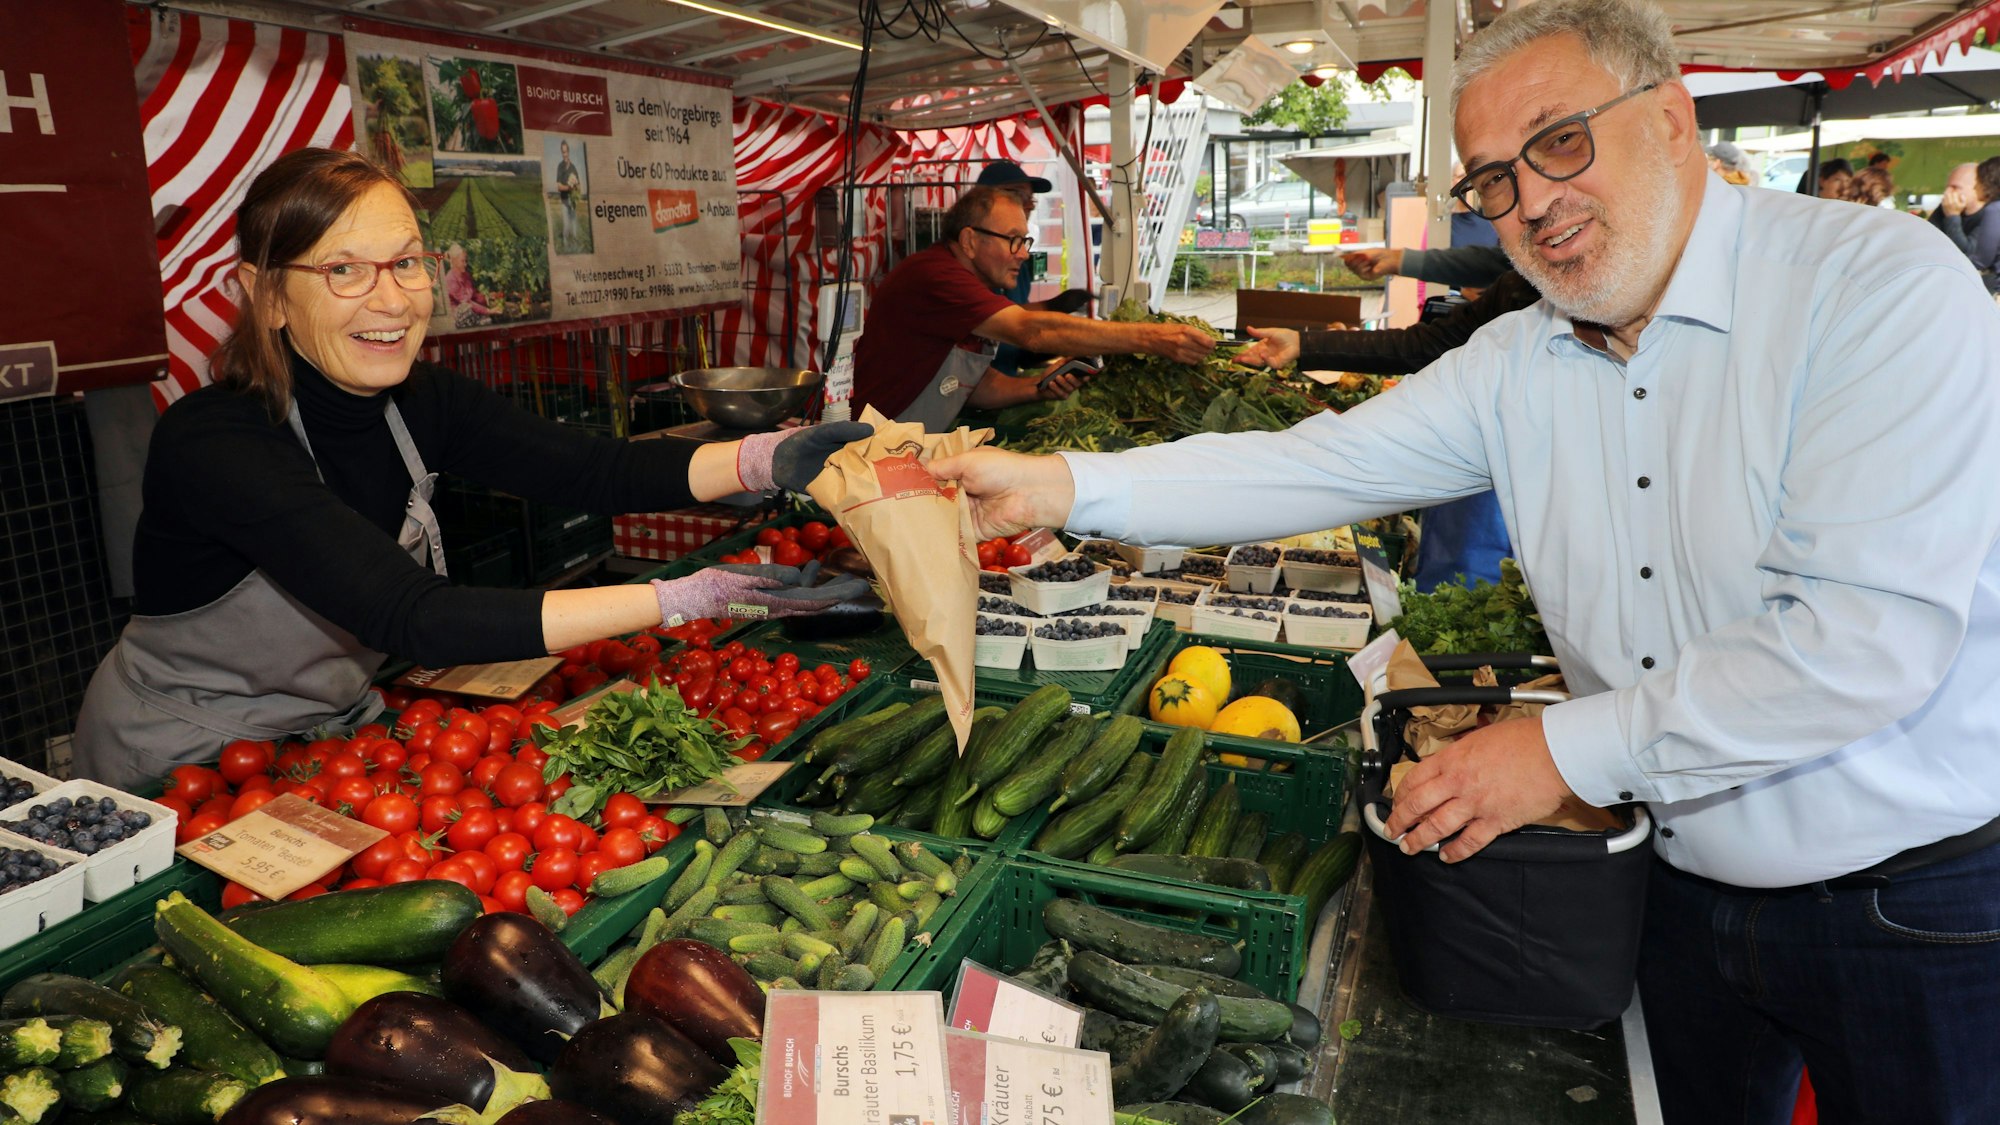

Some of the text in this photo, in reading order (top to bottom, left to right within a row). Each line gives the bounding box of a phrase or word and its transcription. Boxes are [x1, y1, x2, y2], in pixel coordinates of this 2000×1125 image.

[526, 85, 604, 106] BIOHOF BURSCH
[615, 97, 722, 128] aus dem Vorgebirge
[644, 125, 690, 145] seit 1964
[617, 156, 727, 182] Über 60 Produkte aus
[595, 199, 647, 223] eigenem
[656, 199, 692, 223] demeter
[706, 201, 735, 217] Anbau
[573, 264, 645, 284] Weidenpeschweg
[646, 264, 656, 279] 31
[235, 828, 275, 853] Tomaten
[269, 828, 307, 848] Burschs
[240, 855, 274, 877] 5,95
[269, 869, 286, 881] €
[891, 1024, 912, 1036] €
[783, 1037, 795, 1098] BIOHOF BURSCH
[832, 1045, 850, 1096] Burschs
[858, 1014, 881, 1125] räuter Basilikum
[892, 1041, 920, 1077] 1,75
[1041, 1083, 1063, 1097] €
